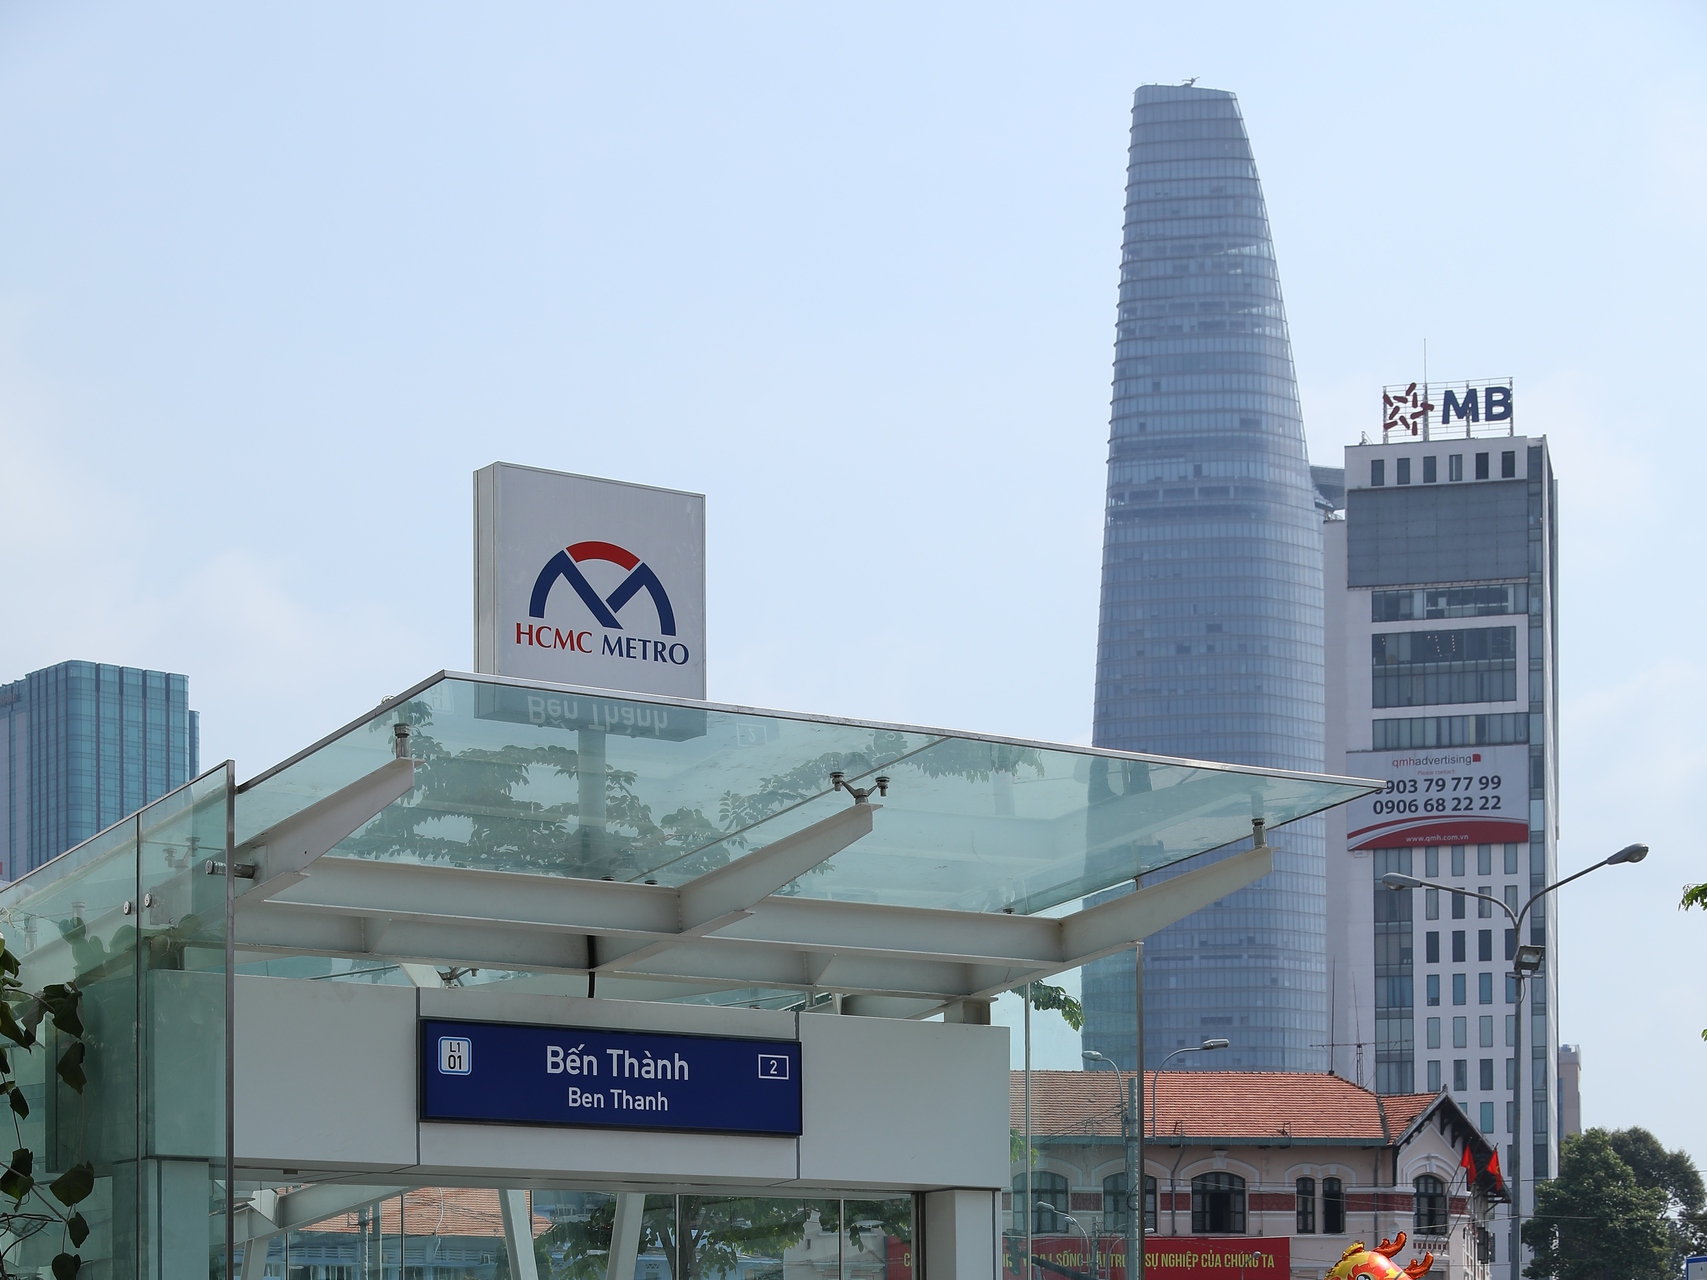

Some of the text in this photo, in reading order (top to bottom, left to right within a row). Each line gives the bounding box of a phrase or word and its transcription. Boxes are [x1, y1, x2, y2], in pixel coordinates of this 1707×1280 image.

[1442, 386, 1512, 425] MB
[515, 621, 690, 665] HCMC METRO
[1392, 754, 1472, 769] qmhadvertising
[1374, 775, 1502, 795] 903 79 77 99
[1373, 795, 1502, 815] 0906 68 22 22
[1405, 833, 1469, 843] www.qmh.com.vn
[449, 1041, 461, 1053] L1
[447, 1054, 462, 1070] 01
[546, 1043, 689, 1081] Bến Thành
[769, 1059, 778, 1075] 2
[568, 1086, 669, 1112] Ben Thanh
[1056, 1249, 1083, 1268] SỐNG
[1145, 1252, 1159, 1270] SỰ
[1161, 1250, 1199, 1271] NGHIỆP
[1201, 1249, 1222, 1268] CỦA
[1224, 1250, 1259, 1268] CHÚNG
[1261, 1253, 1275, 1268] TA
